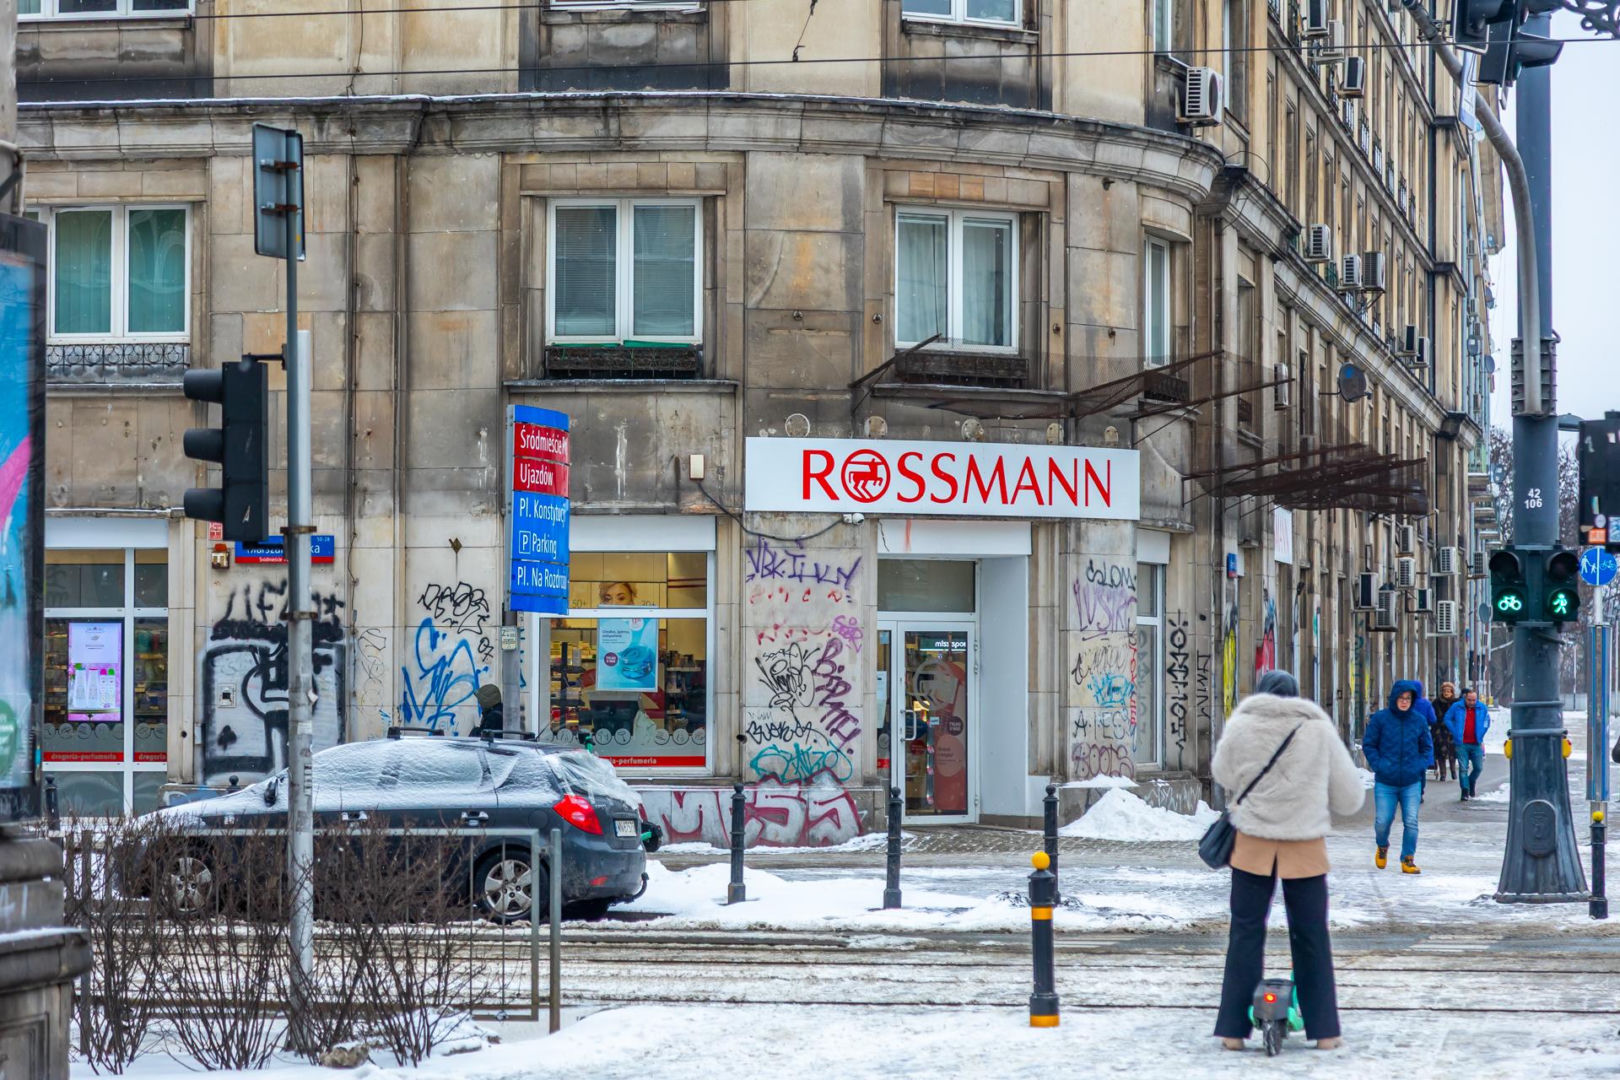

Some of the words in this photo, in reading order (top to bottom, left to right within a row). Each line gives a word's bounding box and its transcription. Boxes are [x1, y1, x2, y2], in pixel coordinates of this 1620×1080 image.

[520, 425, 562, 454] Śródmieście
[520, 463, 553, 488] Ujazdów
[802, 448, 1111, 508] ROSSMANN
[1524, 499, 1543, 509] 106
[1528, 488, 1541, 499] 42
[519, 498, 531, 518] Pl.
[522, 534, 529, 551] P
[532, 533, 557, 559] Parking
[517, 566, 529, 587] Pl.
[532, 567, 542, 587] Na
[610, 757, 657, 765] ia-perfumeria
